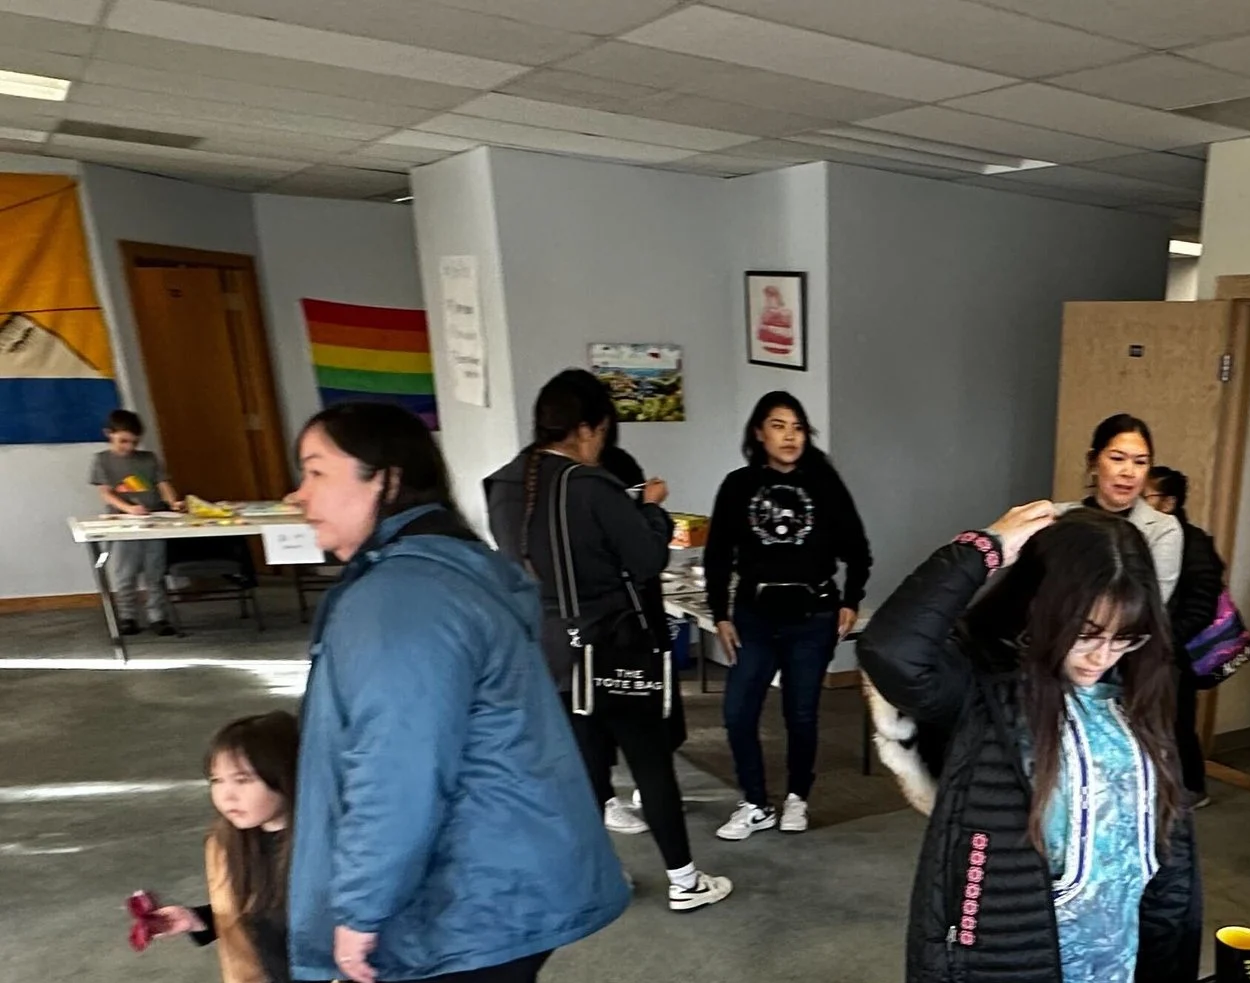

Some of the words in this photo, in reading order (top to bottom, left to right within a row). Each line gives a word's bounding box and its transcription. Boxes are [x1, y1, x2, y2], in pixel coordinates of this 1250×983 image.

[614, 669, 643, 679] THE
[593, 677, 631, 688] TOTE
[633, 681, 664, 690] BAG
